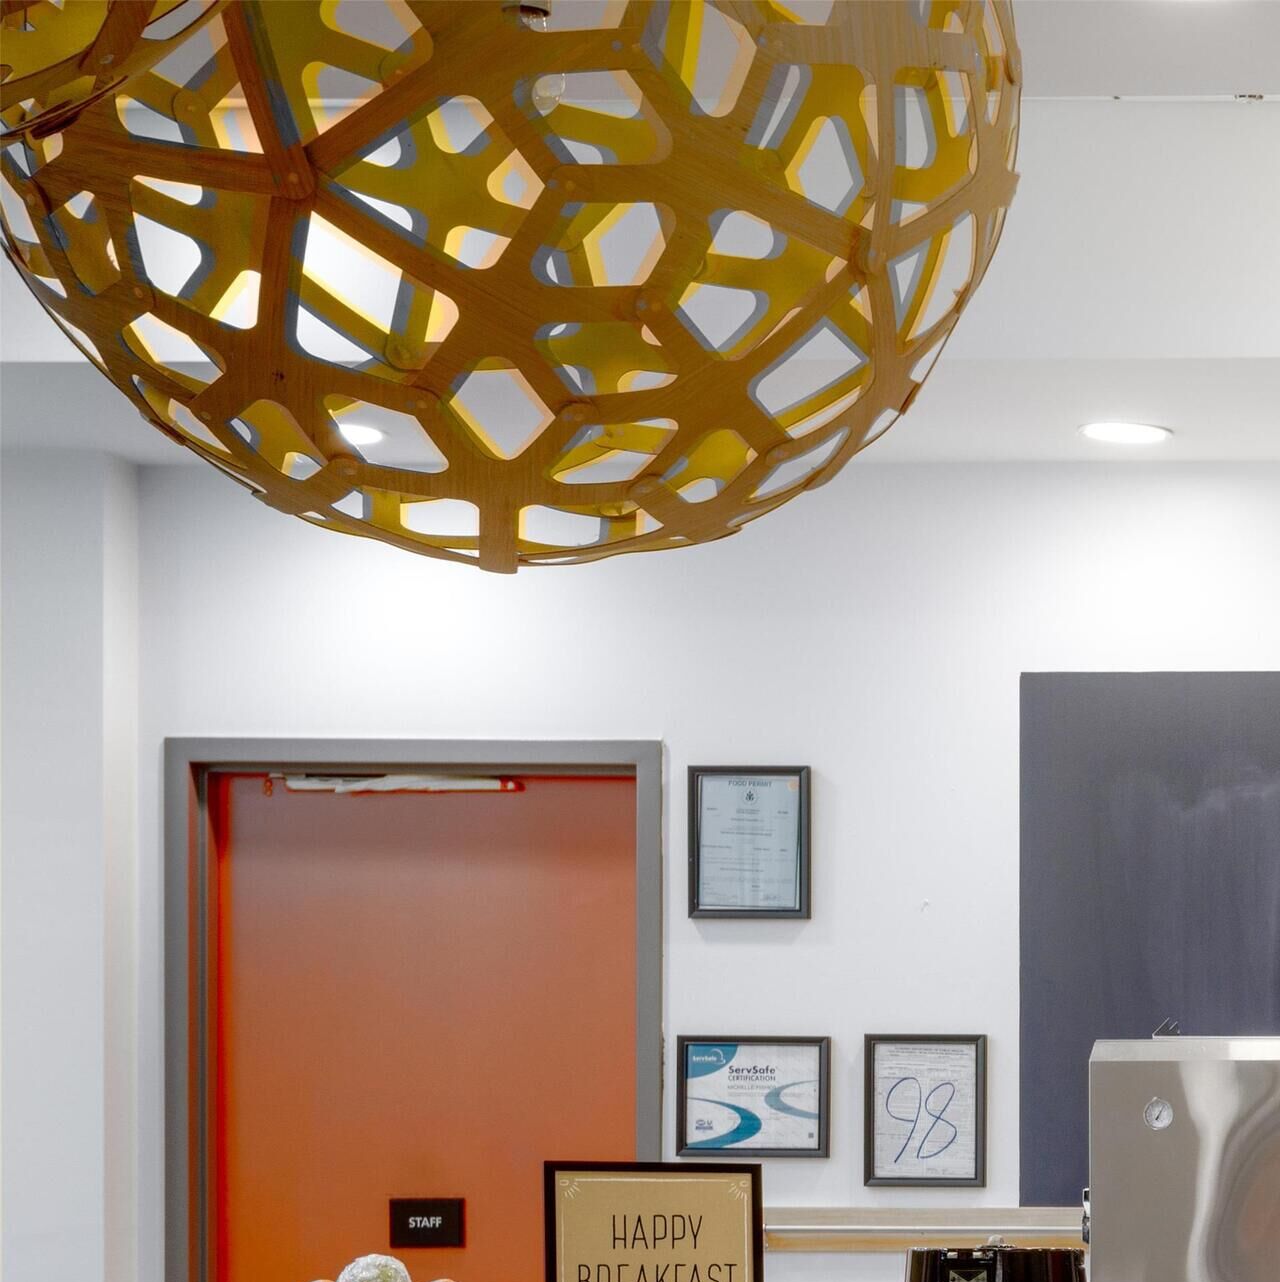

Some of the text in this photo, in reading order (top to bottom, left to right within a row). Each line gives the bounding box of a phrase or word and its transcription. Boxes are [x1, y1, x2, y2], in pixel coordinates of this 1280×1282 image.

[728, 1065, 776, 1074] ServSafe
[886, 1076, 957, 1163] 98
[408, 1216, 442, 1228] STAFF
[612, 1214, 703, 1250] HAPPY
